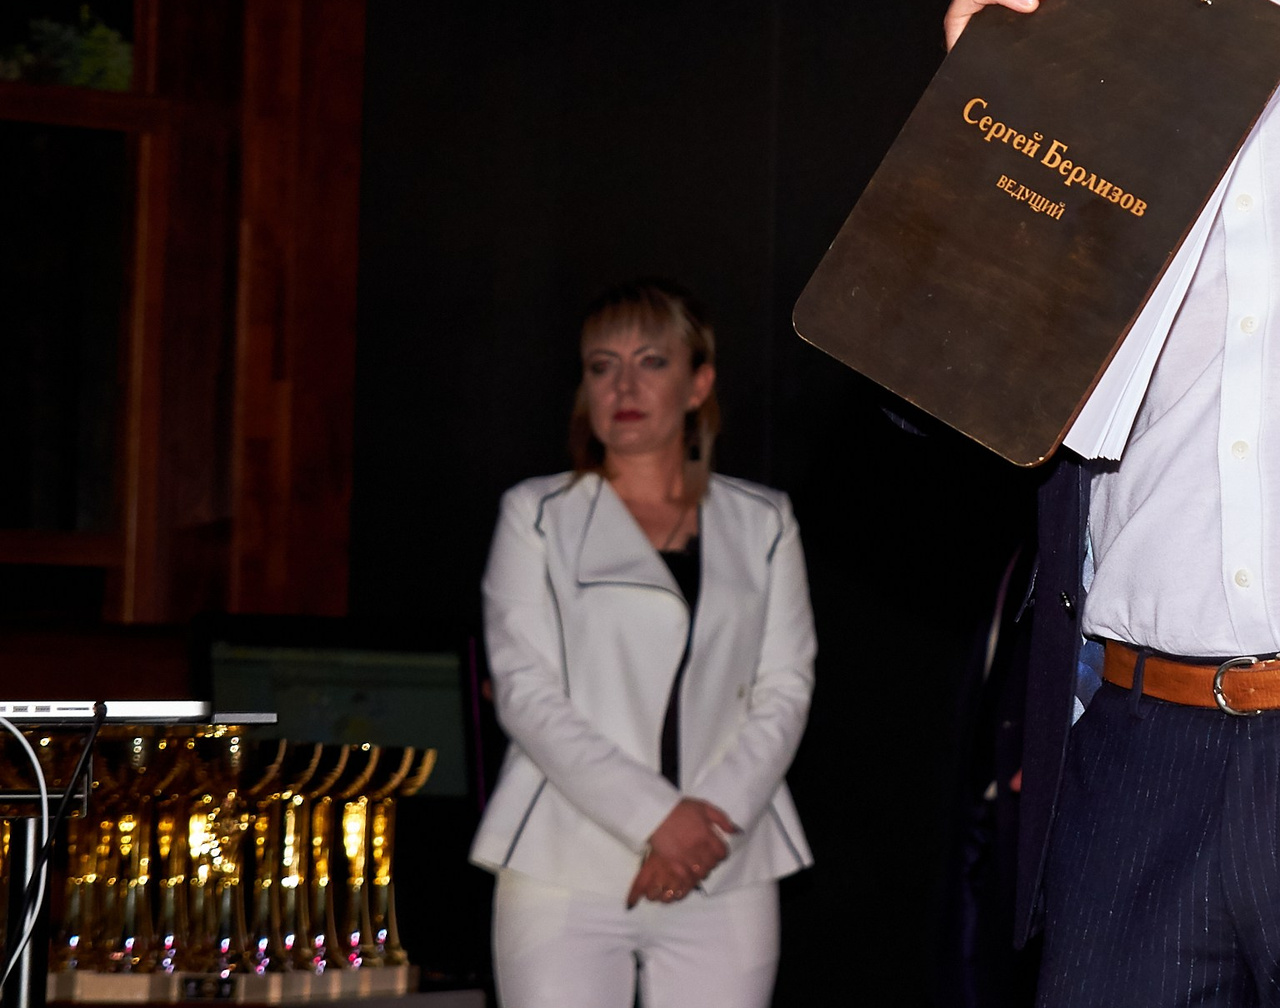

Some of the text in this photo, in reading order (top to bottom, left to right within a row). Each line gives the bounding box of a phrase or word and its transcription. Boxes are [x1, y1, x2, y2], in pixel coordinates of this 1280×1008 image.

[962, 97, 1148, 218] Сергей Берлизов
[996, 174, 1066, 221] ВЕДУЩИЙ
